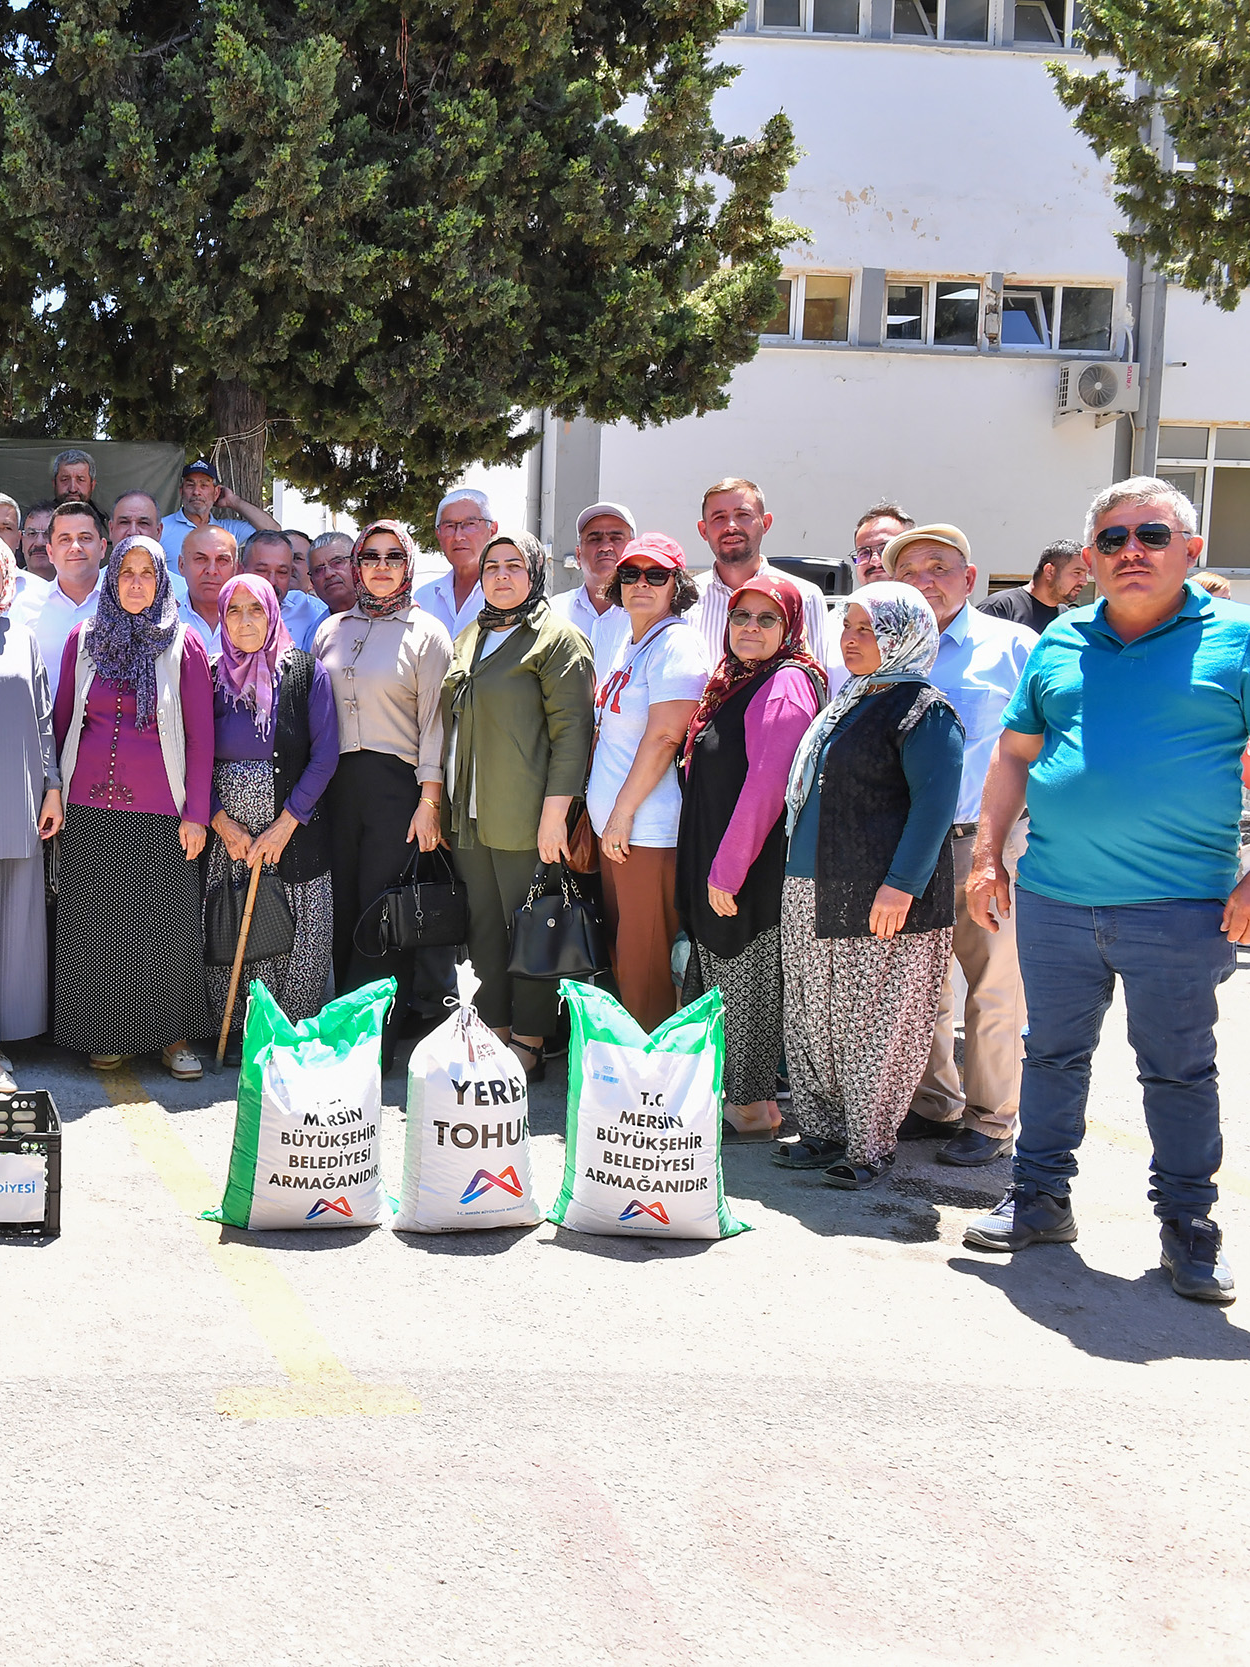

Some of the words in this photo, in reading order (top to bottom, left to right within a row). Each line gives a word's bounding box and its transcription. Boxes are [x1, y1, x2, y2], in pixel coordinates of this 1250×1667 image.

[619, 1111, 684, 1130] MERSİN
[280, 1122, 376, 1149] BÜYÜKŞEHİR
[596, 1126, 702, 1154] BÜYÜKŞEHİR
[288, 1144, 371, 1169] BELEDİYESİ
[603, 1150, 695, 1172] BELEDİYESİ
[268, 1164, 379, 1190] ARMAĞANIDIR
[585, 1167, 708, 1193] ARMAĞANIDIR
